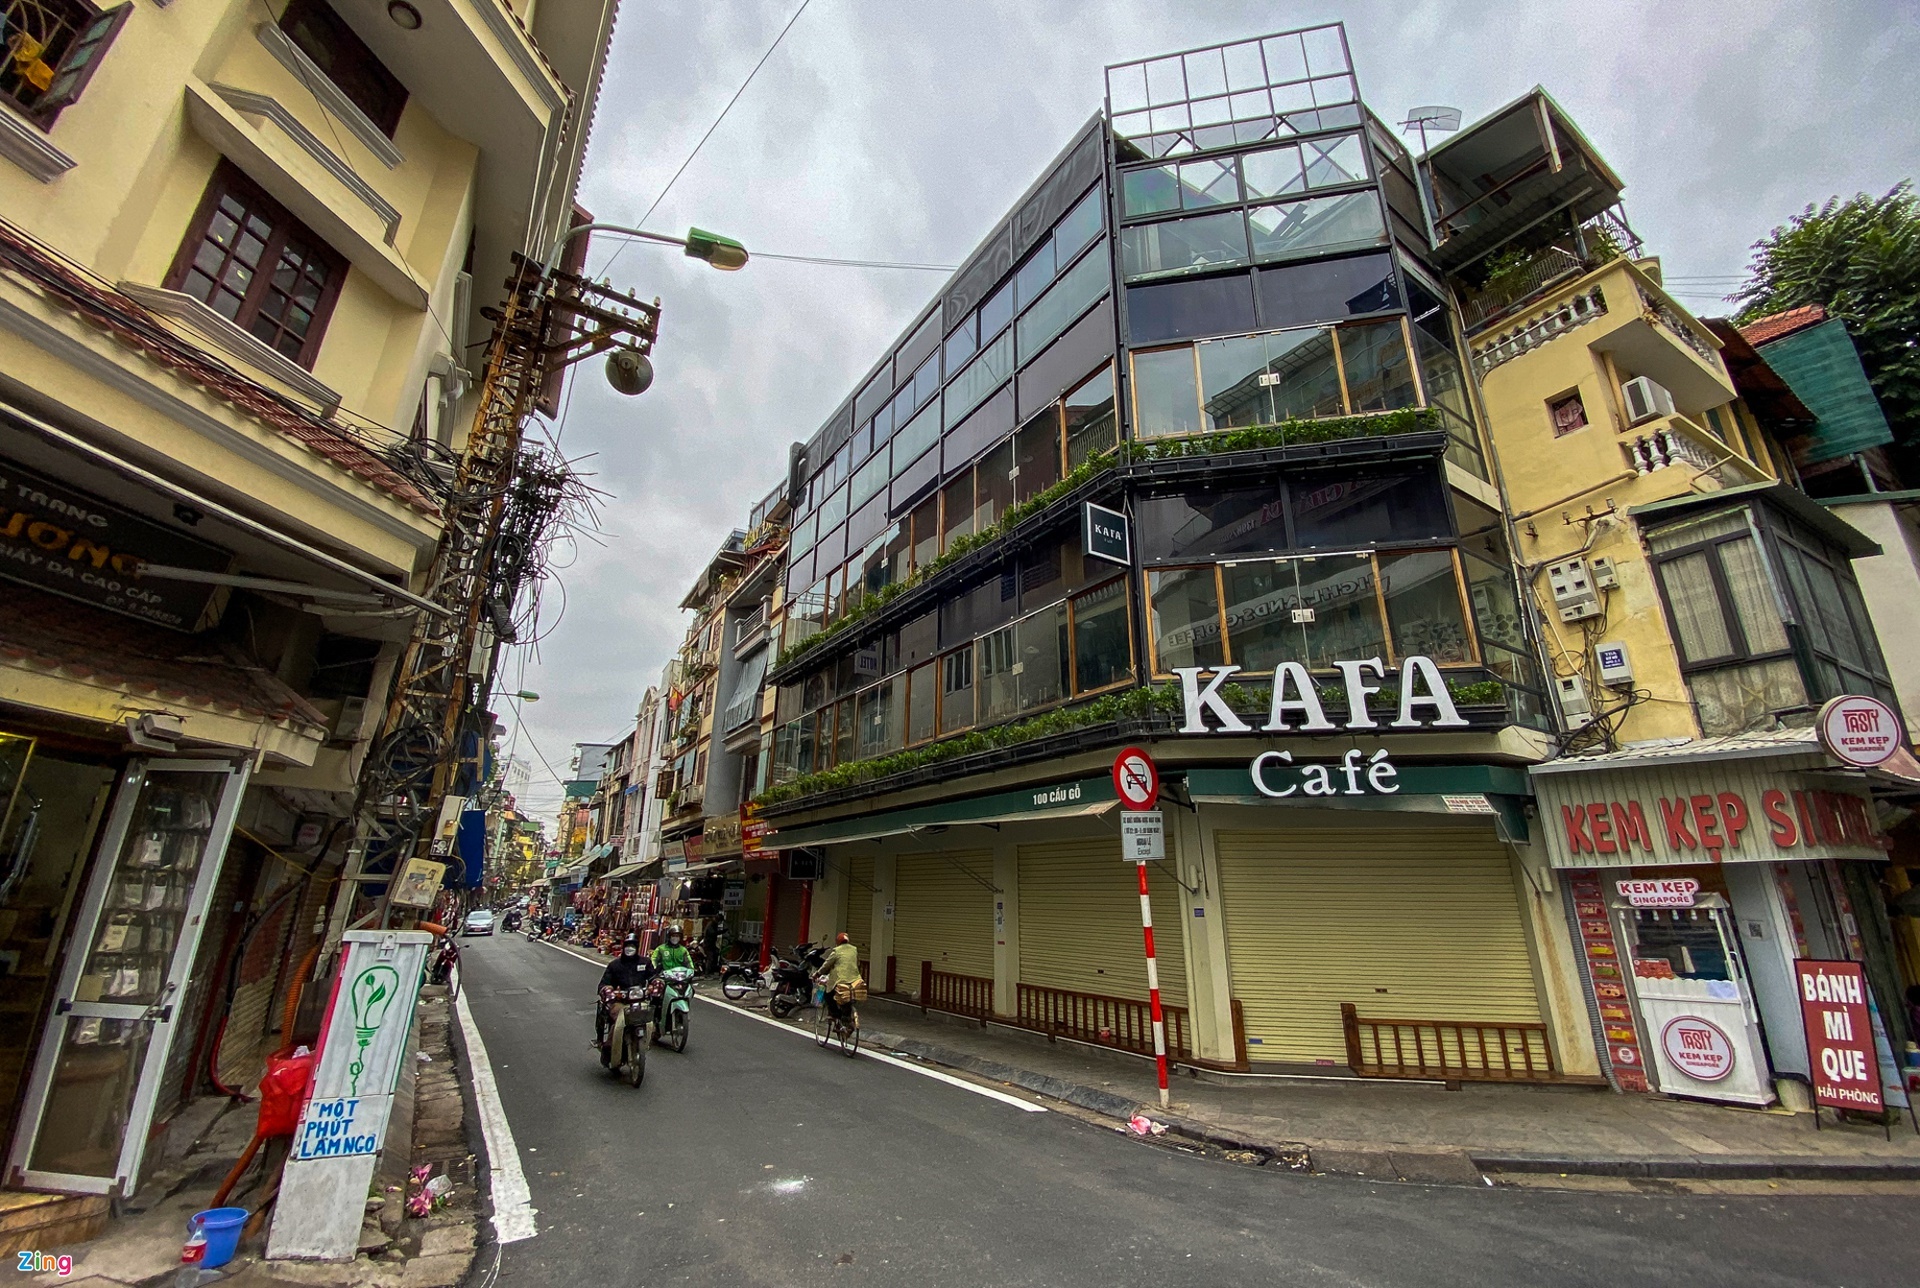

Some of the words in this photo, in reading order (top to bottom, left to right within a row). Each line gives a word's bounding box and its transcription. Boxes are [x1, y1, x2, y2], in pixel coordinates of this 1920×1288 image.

[1094, 523, 1122, 541] KAFA
[80, 572, 121, 591] CAO
[1171, 655, 1470, 734] KAFA
[1842, 708, 1879, 733] TASTY
[1841, 737, 1866, 745] KEM
[1868, 736, 1890, 747] KẸP
[1249, 748, 1400, 797] Café
[1033, 793, 1048, 805] 100
[1561, 800, 1652, 854] KEM
[1658, 791, 1748, 863] KẸP
[1620, 881, 1658, 894] KEM
[1662, 881, 1695, 896] KẸP
[1633, 896, 1690, 904] SINGAPORE
[1802, 968, 1862, 1004] BÁNH
[1823, 1005, 1853, 1041] MÌ
[1678, 1028, 1713, 1051] TASTY
[1679, 1052, 1701, 1061] KEM
[1821, 1047, 1867, 1083] QUE
[1817, 1083, 1837, 1099] HẢI
[1839, 1085, 1880, 1105] PHÒNG
[304, 1116, 354, 1138] PHÚT
